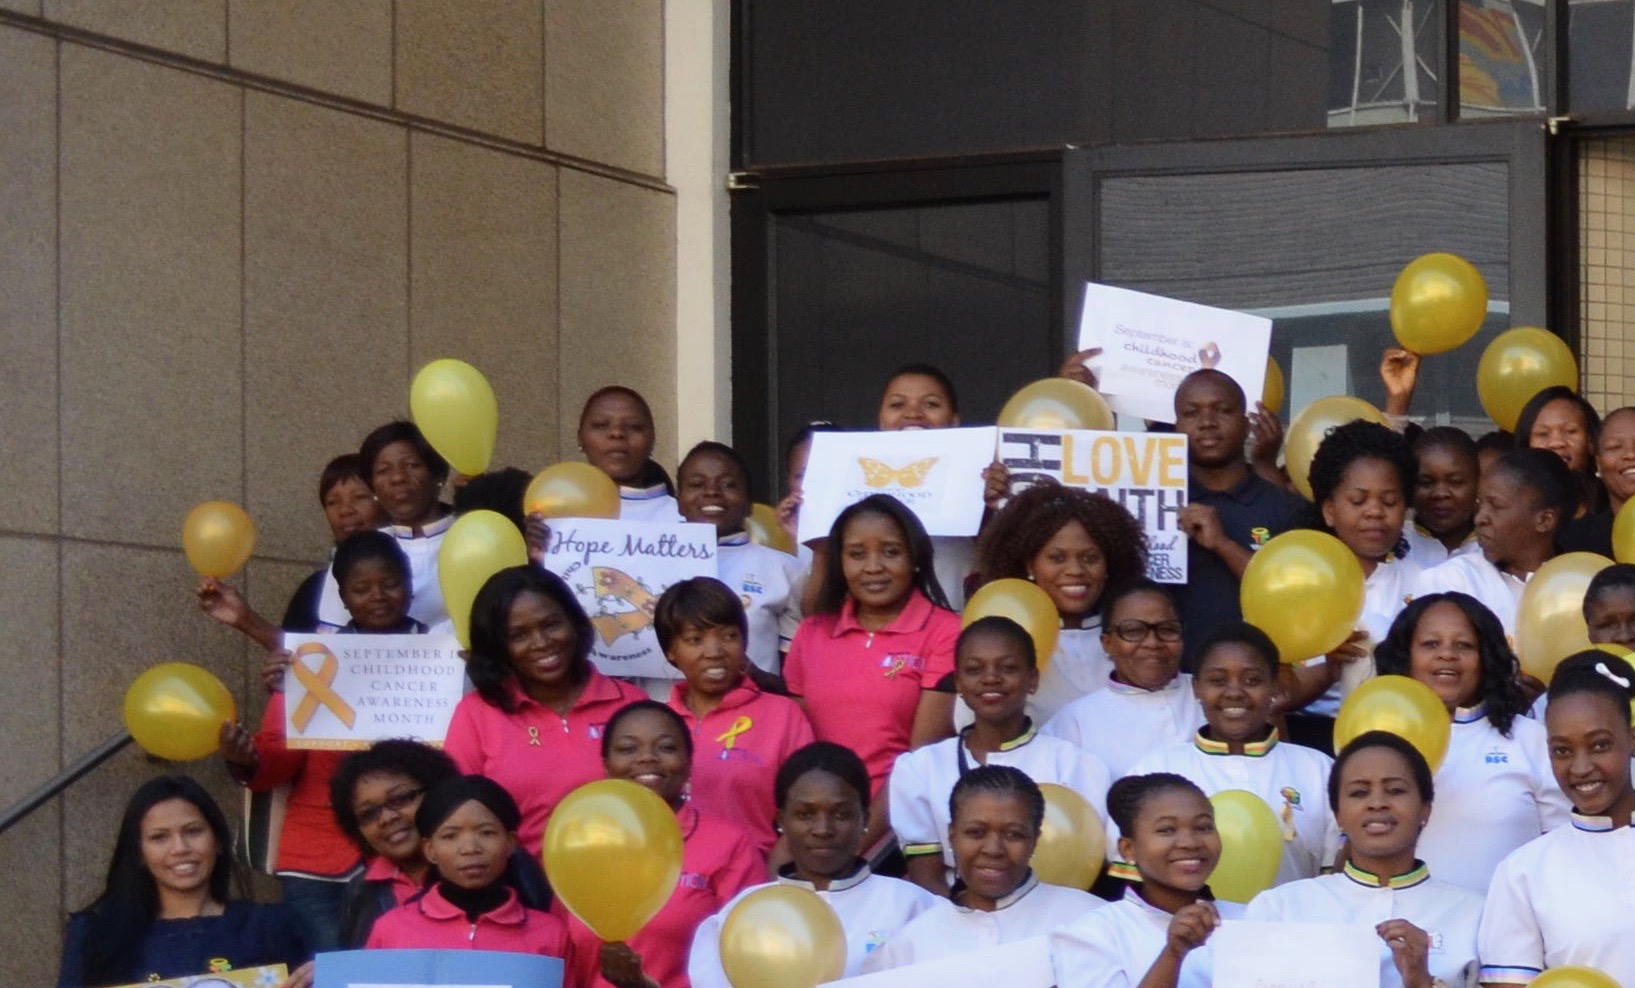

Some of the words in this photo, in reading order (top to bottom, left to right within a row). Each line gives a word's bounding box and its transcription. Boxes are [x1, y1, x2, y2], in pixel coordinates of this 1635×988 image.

[1114, 323, 1180, 346] September
[1123, 343, 1198, 365] childhood
[1146, 358, 1194, 373] cancer
[1062, 434, 1186, 487] LOVE
[551, 529, 615, 566] Hope
[617, 533, 714, 559] Matters
[343, 649, 442, 660] SEPTEMBER
[350, 665, 456, 676] CHILDHOOD
[371, 681, 438, 691] CANCER
[357, 698, 449, 708] AWARENESS
[374, 714, 435, 724] MONTH
[1485, 755, 1508, 765] BSC
